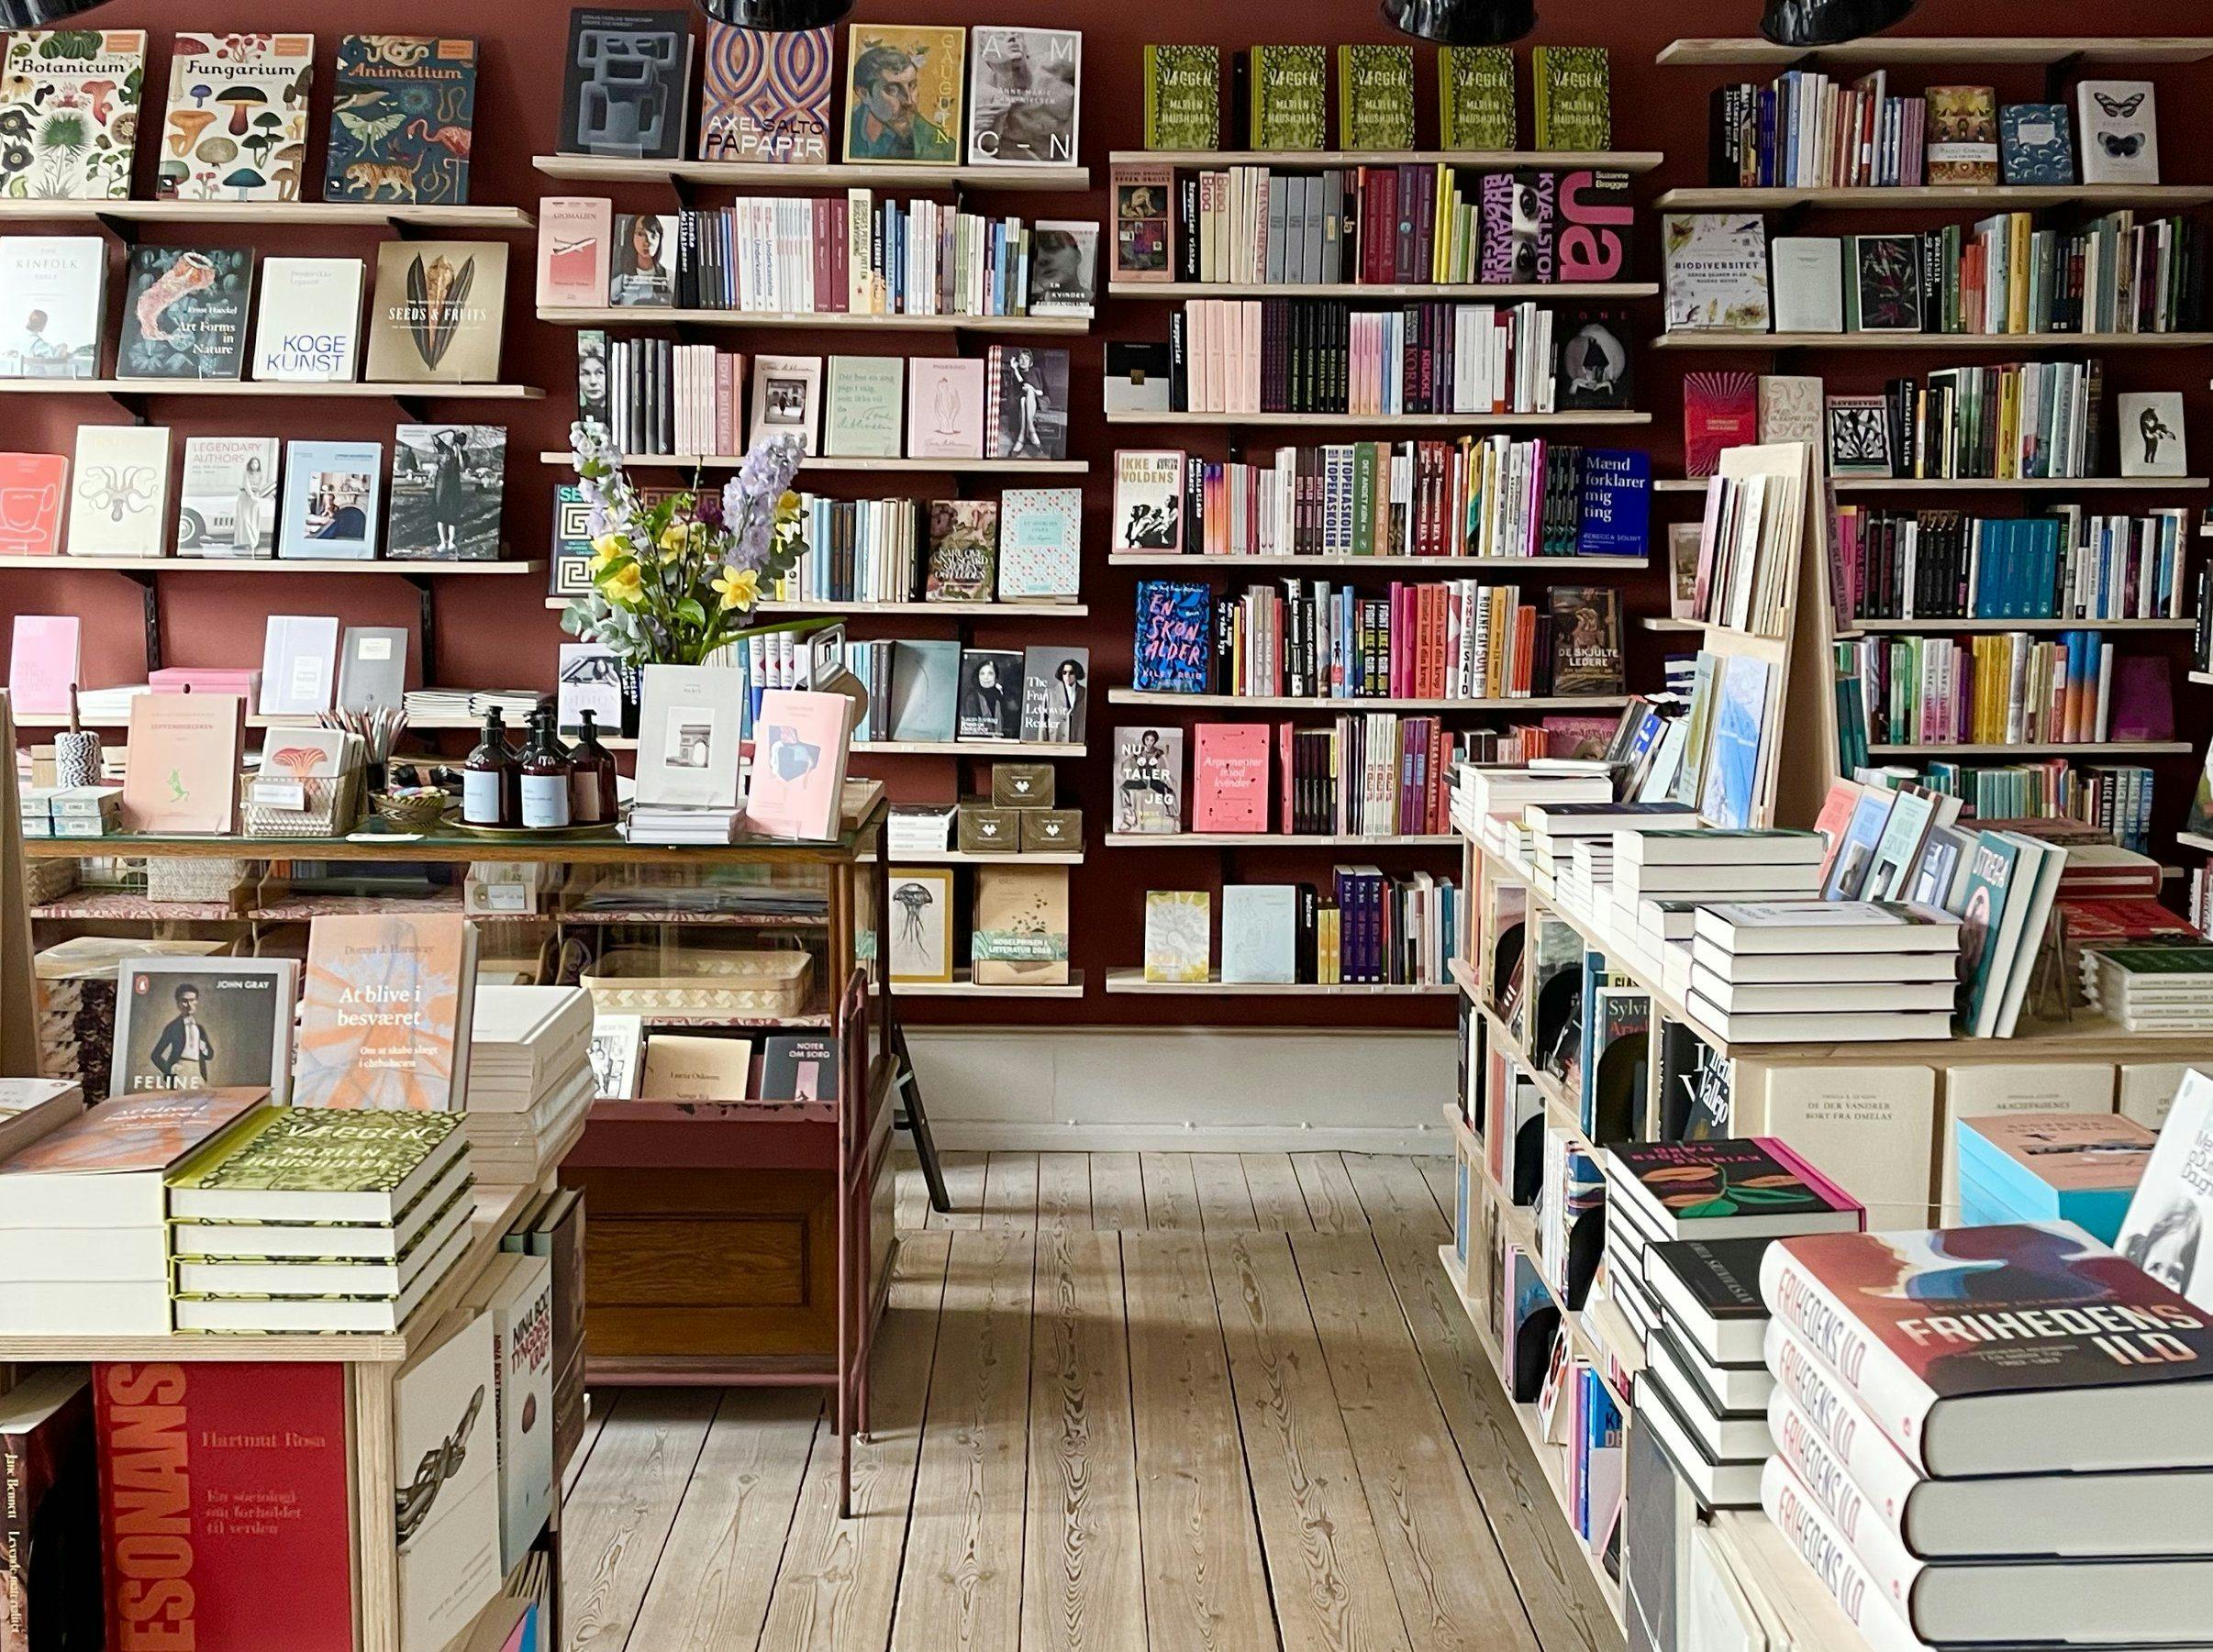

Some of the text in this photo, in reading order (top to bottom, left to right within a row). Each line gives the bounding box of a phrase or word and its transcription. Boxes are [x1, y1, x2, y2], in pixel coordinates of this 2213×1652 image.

[981, 36, 1073, 61] A M
[18, 60, 126, 74] Botanicum
[186, 60, 297, 79] Fungarium
[348, 62, 464, 81] Animalium
[1163, 69, 1211, 85] VÆGGEN
[1269, 70, 1318, 85] VÆGGEN
[1358, 70, 1407, 86] VÆGGEN
[1459, 71, 1507, 87] VÆGGEN
[1554, 72, 1602, 88] VÆGGEN
[936, 34, 954, 143] GAUGUIN
[709, 116, 824, 136] AXEL SALTO
[740, 137, 824, 158] PAPIR
[977, 132, 998, 155] C
[1051, 134, 1072, 158] N
[1482, 174, 1501, 283] BRØGGER
[1497, 172, 1514, 283] SUZANNE
[1537, 172, 1554, 284] KVÆLSTOF
[1559, 171, 1635, 282] Ja
[17, 259, 79, 269] KINFOLK
[754, 238, 762, 296] Underkastelse
[1674, 261, 1759, 270] BIODIVERSITET
[388, 307, 487, 321] SEEDS & FRUITS
[179, 321, 237, 333] Art Forms
[223, 333, 235, 344] in
[284, 335, 347, 353] KOGE
[193, 344, 234, 355] Nature
[267, 354, 344, 371] KUNST
[194, 441, 262, 452] LEGENDARY
[194, 454, 245, 463] AUTHORS
[1121, 458, 1150, 471] IKKE
[1586, 457, 1630, 471] Mænd
[1121, 471, 1174, 483] VOLDENS
[1585, 472, 1646, 489] forklarer
[1326, 460, 1339, 548] TOPEKASKOLEN
[1340, 460, 1353, 549] TOPEKASKOLEN
[1585, 491, 1612, 505] mig
[1585, 505, 1612, 522] ting
[1149, 593, 1176, 616] EN
[1480, 595, 1491, 631] ROXANE
[1147, 615, 1201, 644] SKØN
[1478, 633, 1487, 649] GAY
[1144, 641, 1201, 666] ALDER
[1560, 648, 1618, 659] DE SKJULTE
[1569, 658, 1608, 667] LEDERE
[1462, 650, 1471, 695] SAID
[1027, 676, 1048, 688] The
[1027, 690, 1050, 702] Fran
[1121, 744, 1142, 755] NU
[1204, 756, 1262, 768] Argumenter
[1124, 769, 1171, 780] TALER
[1214, 778, 1251, 789] kvinder
[1145, 793, 1173, 804] JEG
[217, 981, 270, 991] JOHN GRAY
[339, 985, 421, 1004] At blive i
[1608, 999, 1649, 1022] Sylvi
[338, 1011, 422, 1027] besværet
[360, 1046, 373, 1056] Om
[388, 1045, 412, 1055] skabe
[796, 1042, 824, 1050] NOTER
[789, 1050, 830, 1059] OM SORG
[134, 1074, 201, 1090] FELINE
[1699, 1066, 1729, 1126] Vallejo
[1807, 1102, 1890, 1110] DE DER VANDRER
[1854, 1112, 1893, 1121] OMELAS
[285, 1124, 434, 1140] VÆGGEN
[282, 1147, 382, 1159] MARLEN
[247, 1157, 395, 1169] HAUSHOFER
[1778, 1267, 1866, 1389] FRIHEDENS ILD
[1896, 1303, 2204, 1347] FRIHEDENS
[2091, 1333, 2200, 1366] ILD
[1780, 1338, 1856, 1467] FRIHEDENS ILD
[201, 1431, 327, 1449] Hartmut Rosa
[5, 1453, 19, 1474] Jane
[1784, 1410, 1862, 1545] FRIHEDENS ILD
[6, 1478, 20, 1519] Bennett
[107, 1363, 196, 1652] ESONANS
[7, 1530, 21, 1573] Levende
[1779, 1485, 1866, 1627] FRIHEDENS ILD
